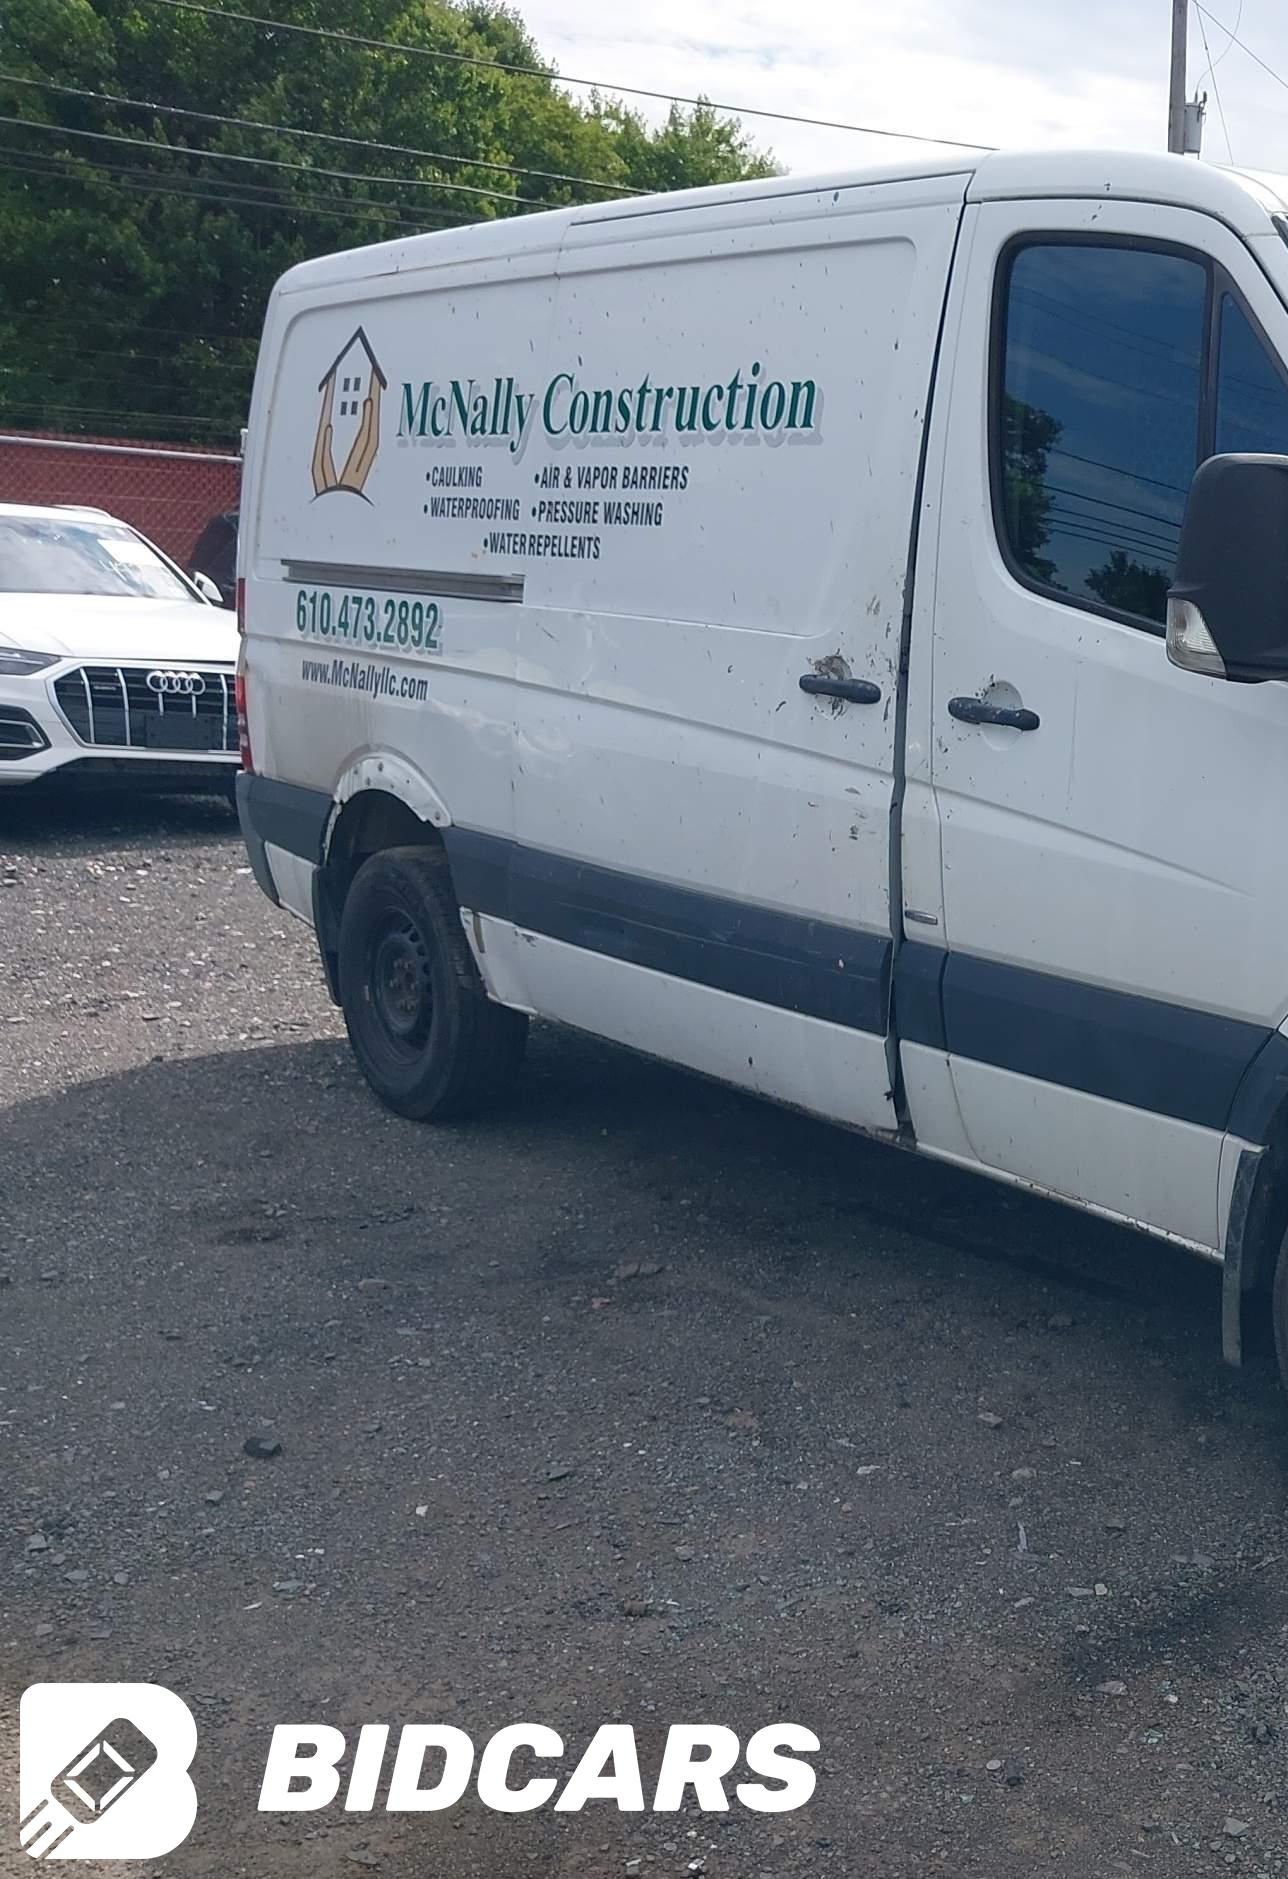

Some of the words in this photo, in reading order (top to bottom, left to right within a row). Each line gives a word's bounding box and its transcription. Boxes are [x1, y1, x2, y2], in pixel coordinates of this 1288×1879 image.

[396, 377, 535, 452] McNally
[543, 362, 817, 437] Construction
[563, 467, 572, 489] &
[577, 466, 618, 490] VAPOR
[621, 466, 689, 490] BARRIERS
[603, 502, 664, 526] WASHING
[528, 534, 601, 559] REPELLENTS
[296, 590, 438, 649] 610.473.2892
[302, 659, 429, 701] www.McNallyllc.com
